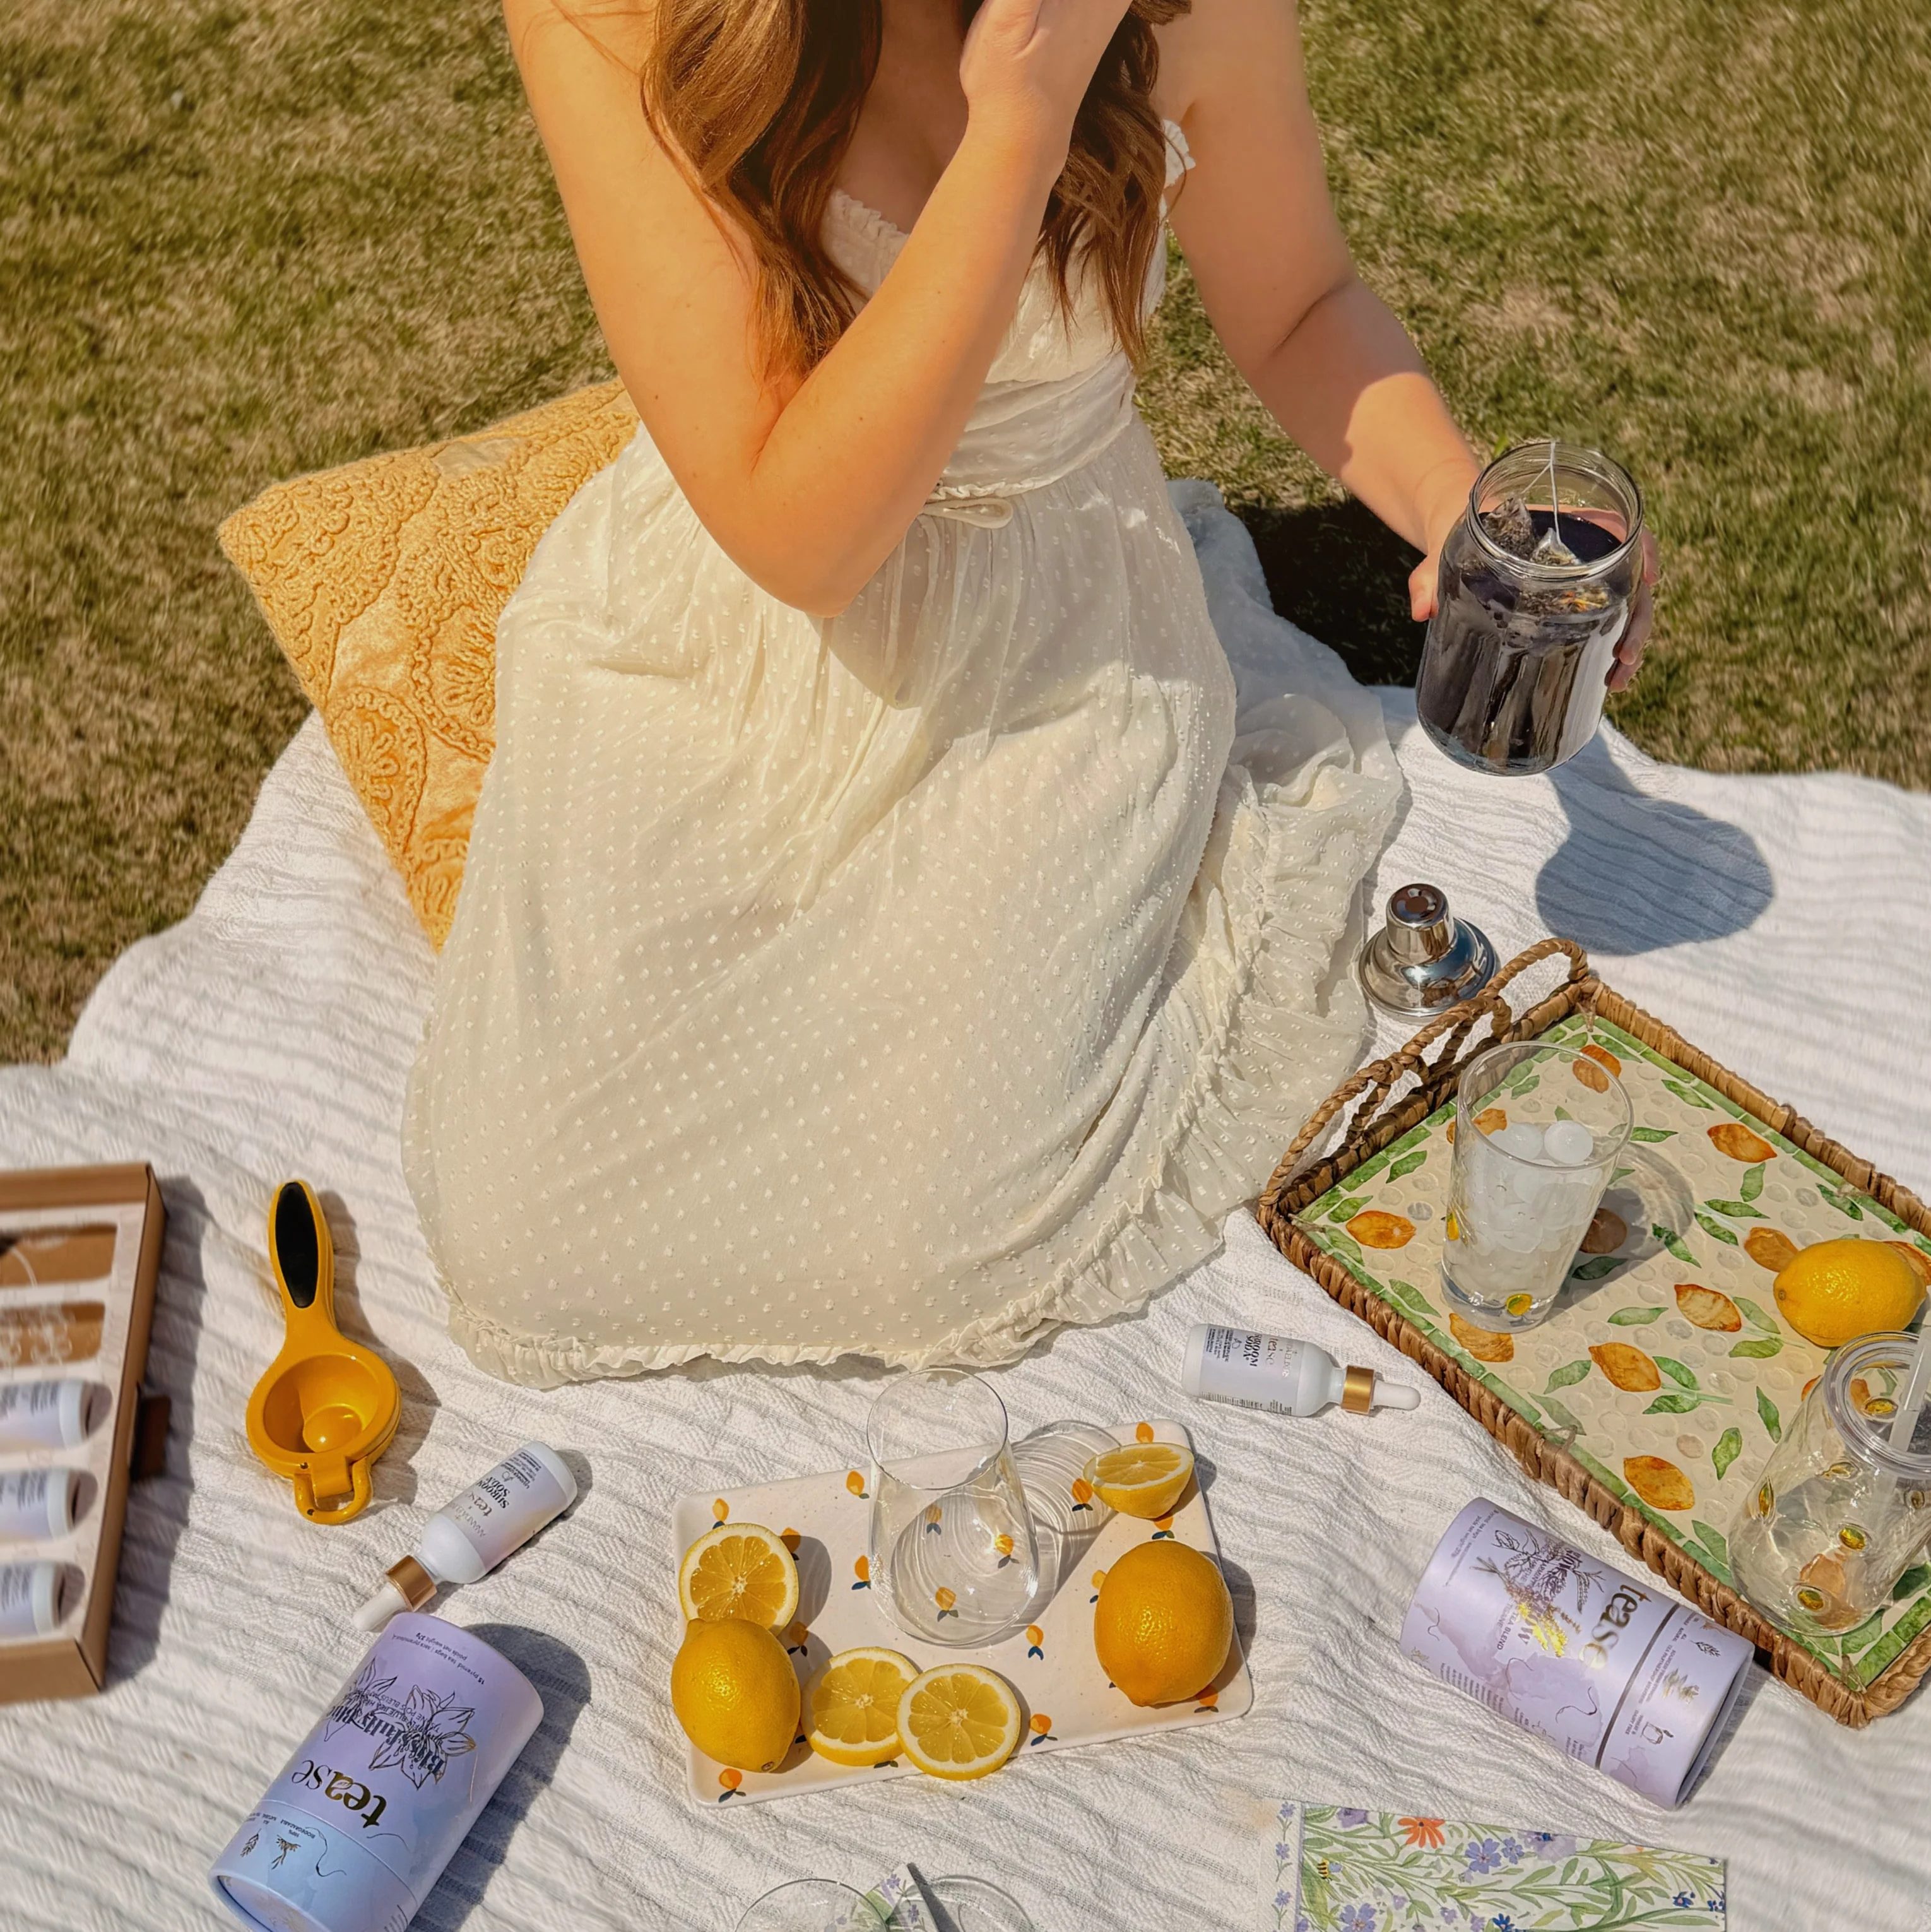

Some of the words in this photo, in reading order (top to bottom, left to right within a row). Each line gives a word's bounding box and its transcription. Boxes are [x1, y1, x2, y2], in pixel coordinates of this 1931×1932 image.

[1577, 1582, 1653, 1673] tease
[1495, 1626, 1511, 1650] BLEND
[434, 1648, 447, 1659] bags
[447, 1656, 456, 1664] tea
[457, 1662, 479, 1679] pyramid
[292, 1760, 387, 1829] tease
